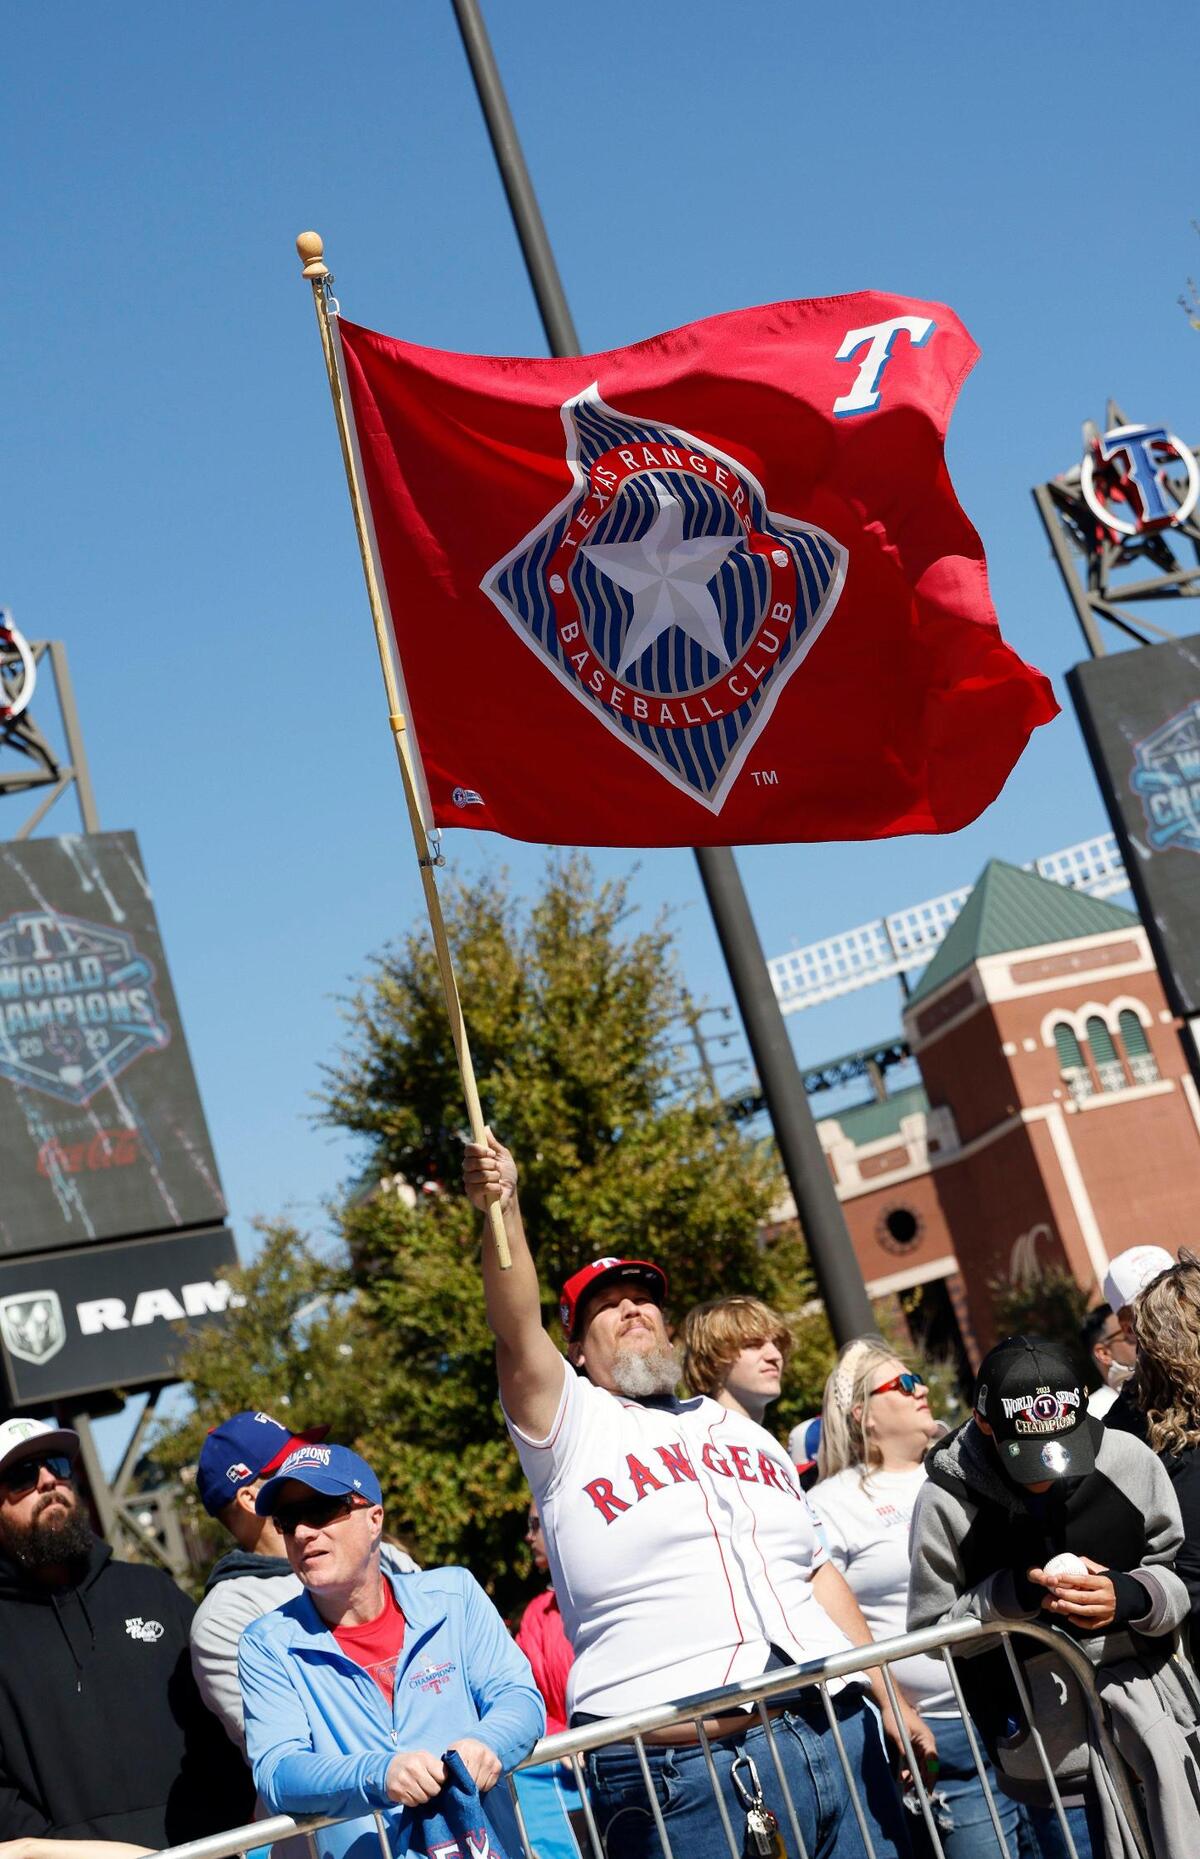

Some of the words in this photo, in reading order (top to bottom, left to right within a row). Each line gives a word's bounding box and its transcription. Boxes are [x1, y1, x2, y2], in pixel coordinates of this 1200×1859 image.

[832, 315, 938, 419] T
[560, 464, 618, 549] TEXAS
[618, 447, 752, 531] RANGERS
[560, 624, 723, 725] BASEBALL
[728, 602, 792, 697] CLUB
[750, 770, 779, 786] TM
[76, 1279, 247, 1336] RAM
[1001, 1395, 1033, 1418] WORLD
[1056, 1388, 1080, 1408] SERIES
[1038, 1399, 1052, 1415] T
[1015, 1411, 1076, 1433] CHAMPIONS
[409, 1664, 456, 1689] CHAMPIONS
